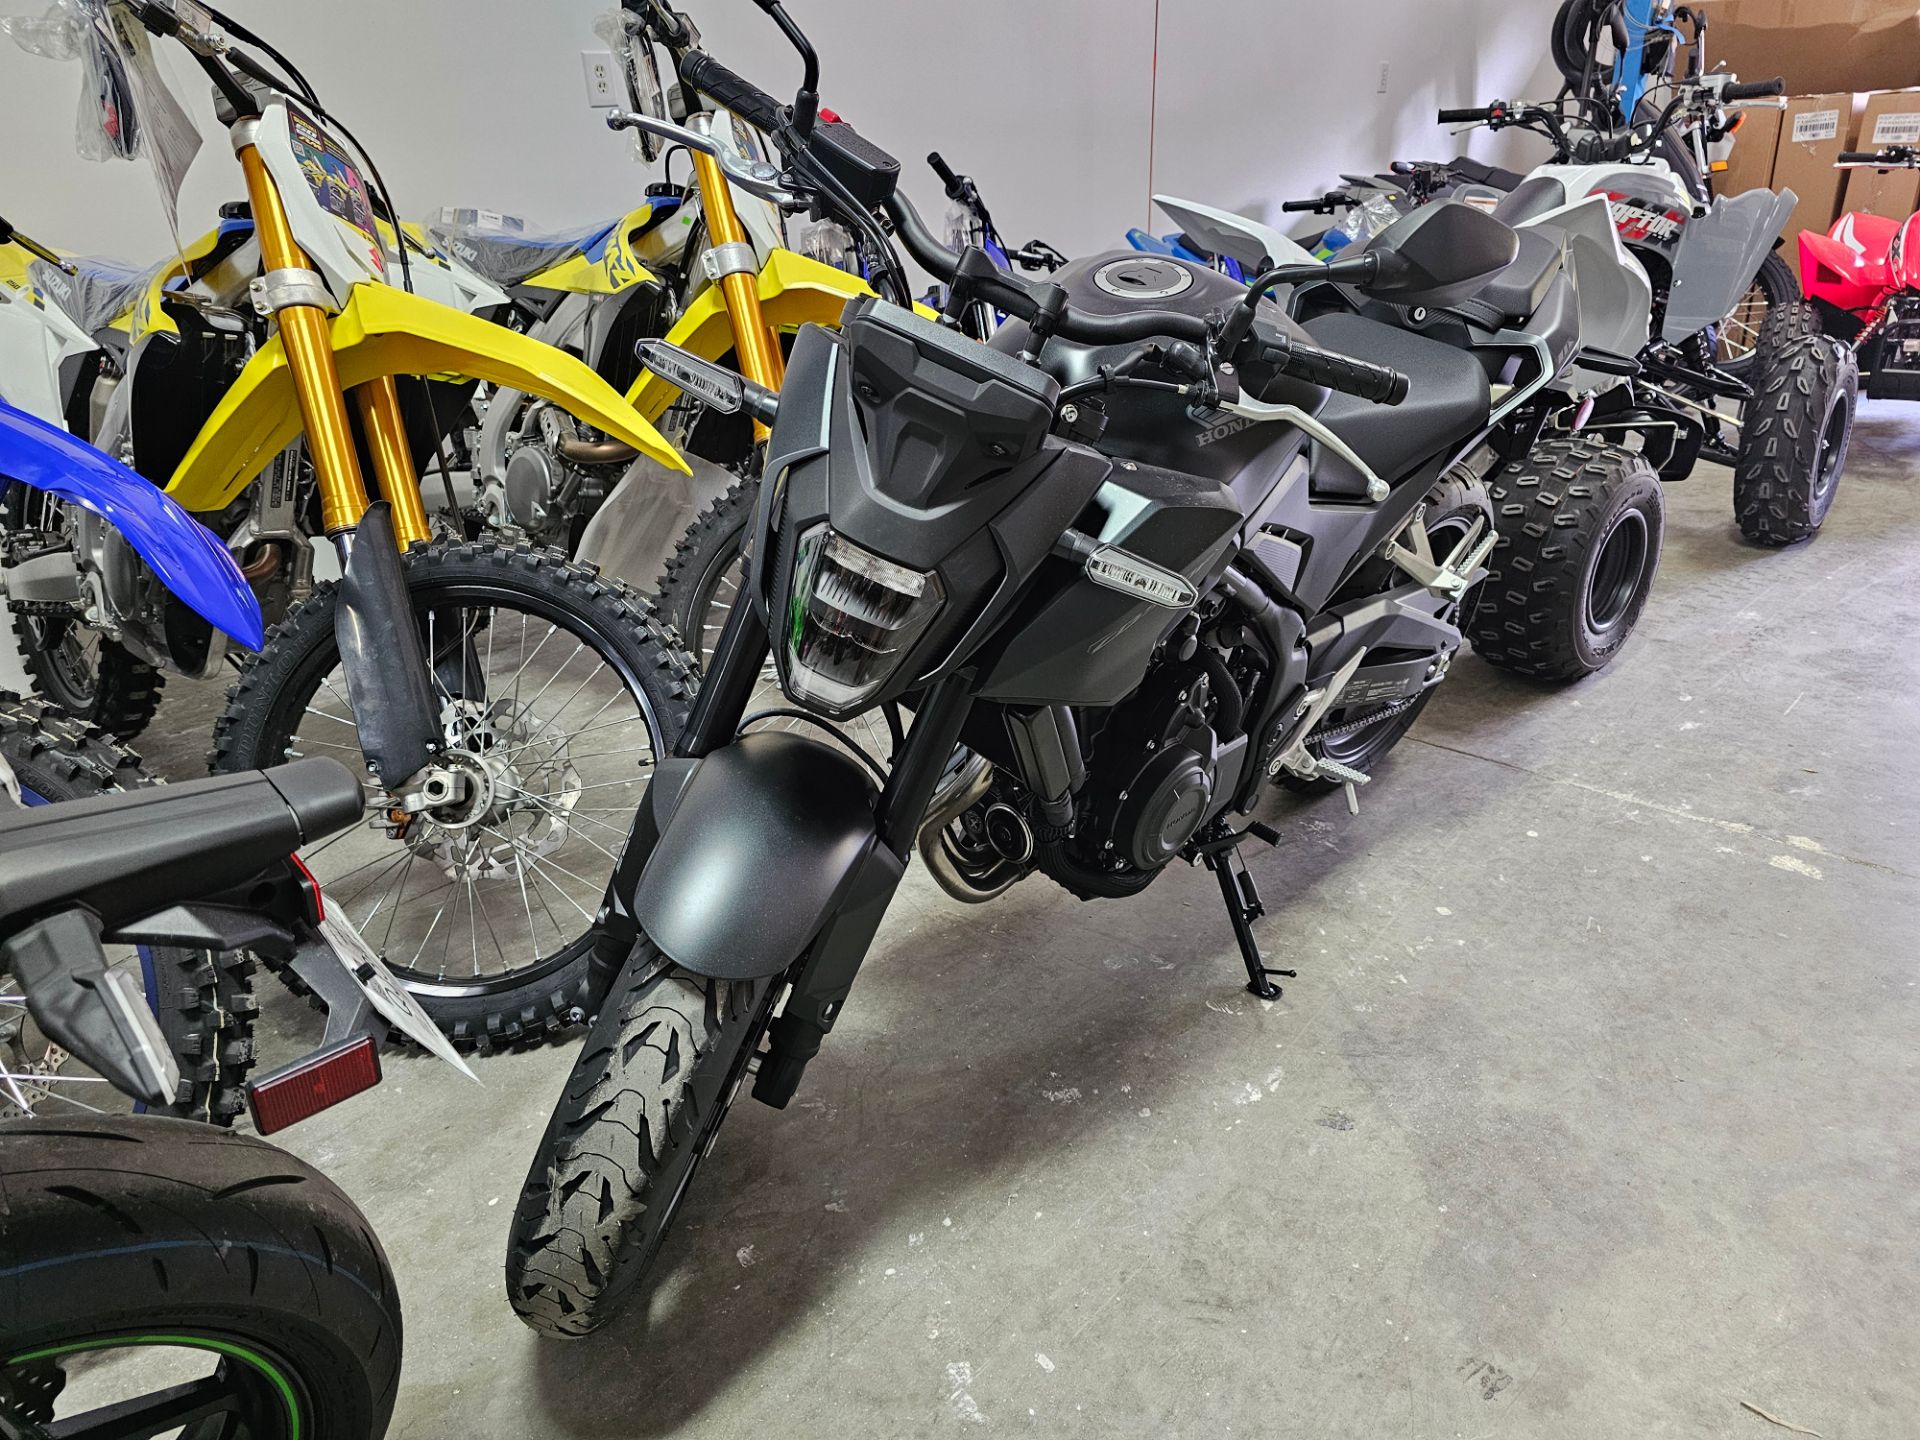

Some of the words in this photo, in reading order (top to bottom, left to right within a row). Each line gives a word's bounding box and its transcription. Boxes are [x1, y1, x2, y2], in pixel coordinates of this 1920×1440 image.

[1611, 202, 1678, 239] APTOR
[441, 236, 478, 262] SZUKI
[6, 278, 22, 290] 250
[42, 268, 74, 302] SUZUKI
[1195, 416, 1257, 448] HOND
